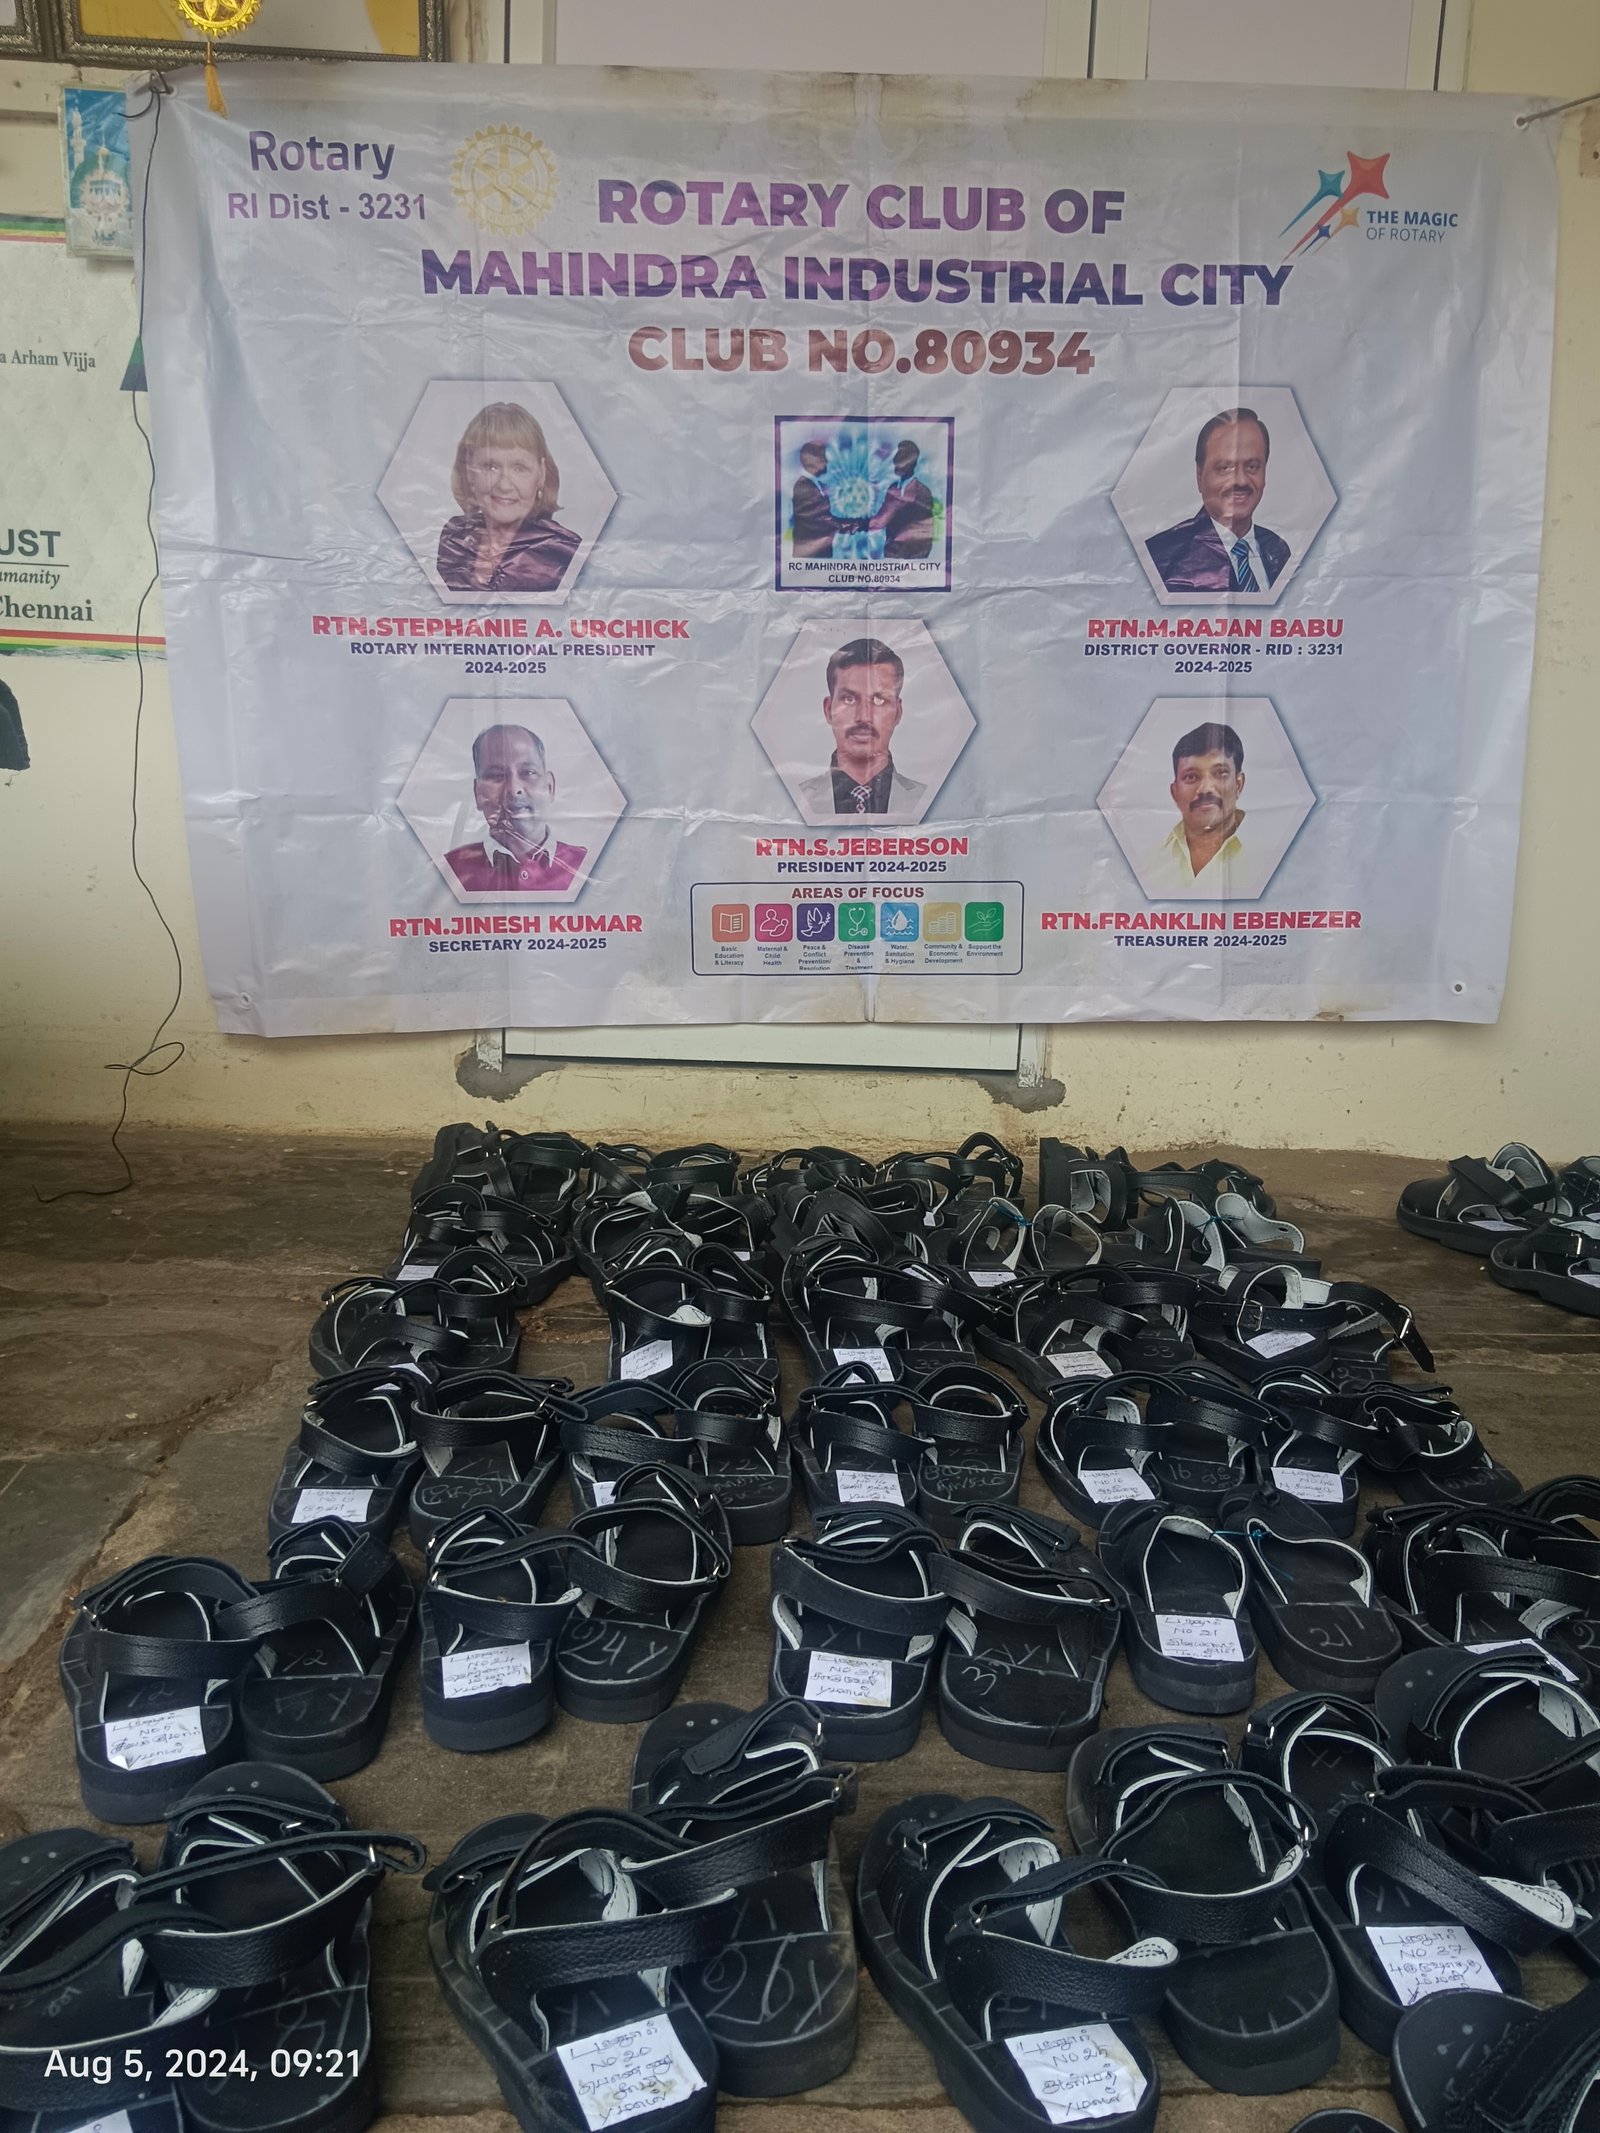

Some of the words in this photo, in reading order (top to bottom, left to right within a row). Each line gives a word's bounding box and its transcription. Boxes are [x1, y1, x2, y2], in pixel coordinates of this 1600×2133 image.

[249, 130, 395, 180] Rotary
[228, 192, 258, 219] RI
[269, 193, 330, 220] Dist
[339, 205, 350, 213] -
[358, 192, 426, 219] 3231
[599, 178, 849, 227] ROTARY
[866, 184, 1026, 232] CLUB
[1044, 189, 1125, 235] OF
[1366, 210, 1399, 224] THE
[1404, 211, 1458, 227] MAGIC
[1366, 227, 1386, 240] OF
[1390, 228, 1446, 243] ROTARY
[421, 249, 767, 300] MAHINDRA
[784, 256, 1144, 306] INDUSTRIAL
[1160, 263, 1294, 307] CITY
[628, 326, 789, 372] CLUB
[808, 329, 1096, 375] NO.80934
[11, 350, 59, 366] Arham
[63, 352, 96, 372] Vijja
[788, 562, 803, 571] RC
[805, 562, 857, 572] MAHINDRA
[859, 563, 916, 571] INDUSTRIAL
[919, 562, 941, 571] CITY
[828, 574, 855, 583] CLUB
[857, 574, 901, 583] NO.80934
[312, 615, 528, 638] RTN.STEPHANIE
[535, 618, 562, 638] A.
[570, 618, 690, 639] URCHICK
[1087, 618, 1263, 638] RTN.M.RAJAN
[1270, 618, 1344, 638] BABU
[350, 642, 418, 656] ROTARY
[423, 642, 558, 657] INTERNATIONAL
[562, 643, 656, 657] PRESIDENT
[1084, 643, 1159, 656] DISTRICT
[1163, 643, 1252, 656] GOVERNOR
[1265, 643, 1293, 656] RID
[1308, 643, 1343, 656] 3231
[464, 660, 548, 675] 2024-2025
[1174, 660, 1253, 673] 2024-2025
[755, 837, 968, 857] RTN.S.JEBERSON
[777, 861, 865, 873] PRESIDENT
[869, 860, 947, 873] 2024-2025
[791, 887, 843, 899] AREAS
[847, 887, 868, 898] OF
[872, 887, 925, 898] FOCUS
[389, 915, 541, 937] RTN.JINESH
[549, 914, 643, 933] KUMAR
[1041, 911, 1226, 931] RTN.FRANKLIN
[1233, 910, 1362, 930] EBENEZER
[429, 939, 523, 953] SECRETARY
[527, 937, 607, 951] 2024-2025
[923, 943, 958, 951] Community
[968, 943, 992, 951] Support
[1114, 935, 1209, 947] TREASURER
[1213, 934, 1287, 947] 2024-2025
[720, 959, 744, 967] Literacy
[763, 959, 783, 967] Health
[764, 952, 781, 960] Child
[890, 957, 915, 966] Hygiene
[924, 957, 963, 965] Development
[1399, 1948, 1427, 1960] NO
[590, 2054, 618, 2072] NO
